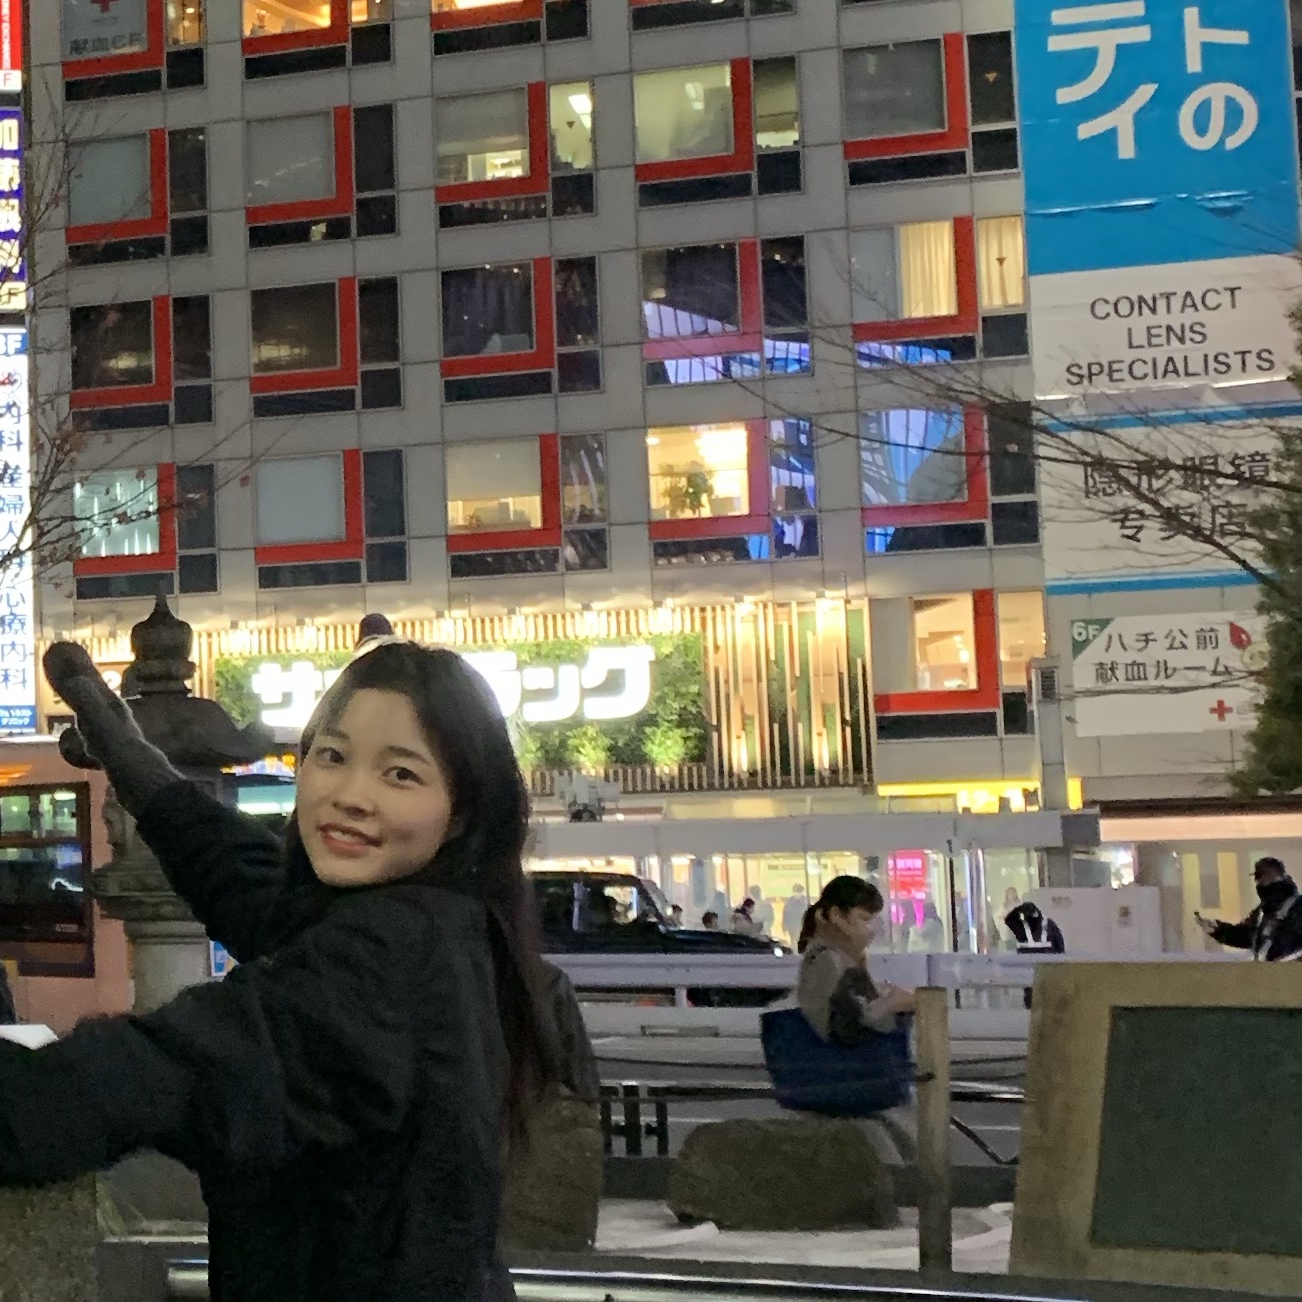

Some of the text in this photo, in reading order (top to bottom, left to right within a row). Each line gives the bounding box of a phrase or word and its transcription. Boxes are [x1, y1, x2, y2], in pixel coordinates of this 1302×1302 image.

[1048, 0, 1159, 160] ティ
[1178, 6, 1259, 151] トの
[1089, 285, 1243, 321] CONTACT
[1126, 321, 1209, 352] LENS
[1064, 348, 1277, 387] SPECIALISTS
[1072, 621, 1101, 643] 6F
[1104, 627, 1221, 653] ハチ公前
[251, 644, 657, 728] サラッグ
[1094, 656, 1234, 684] 献血ルーム
